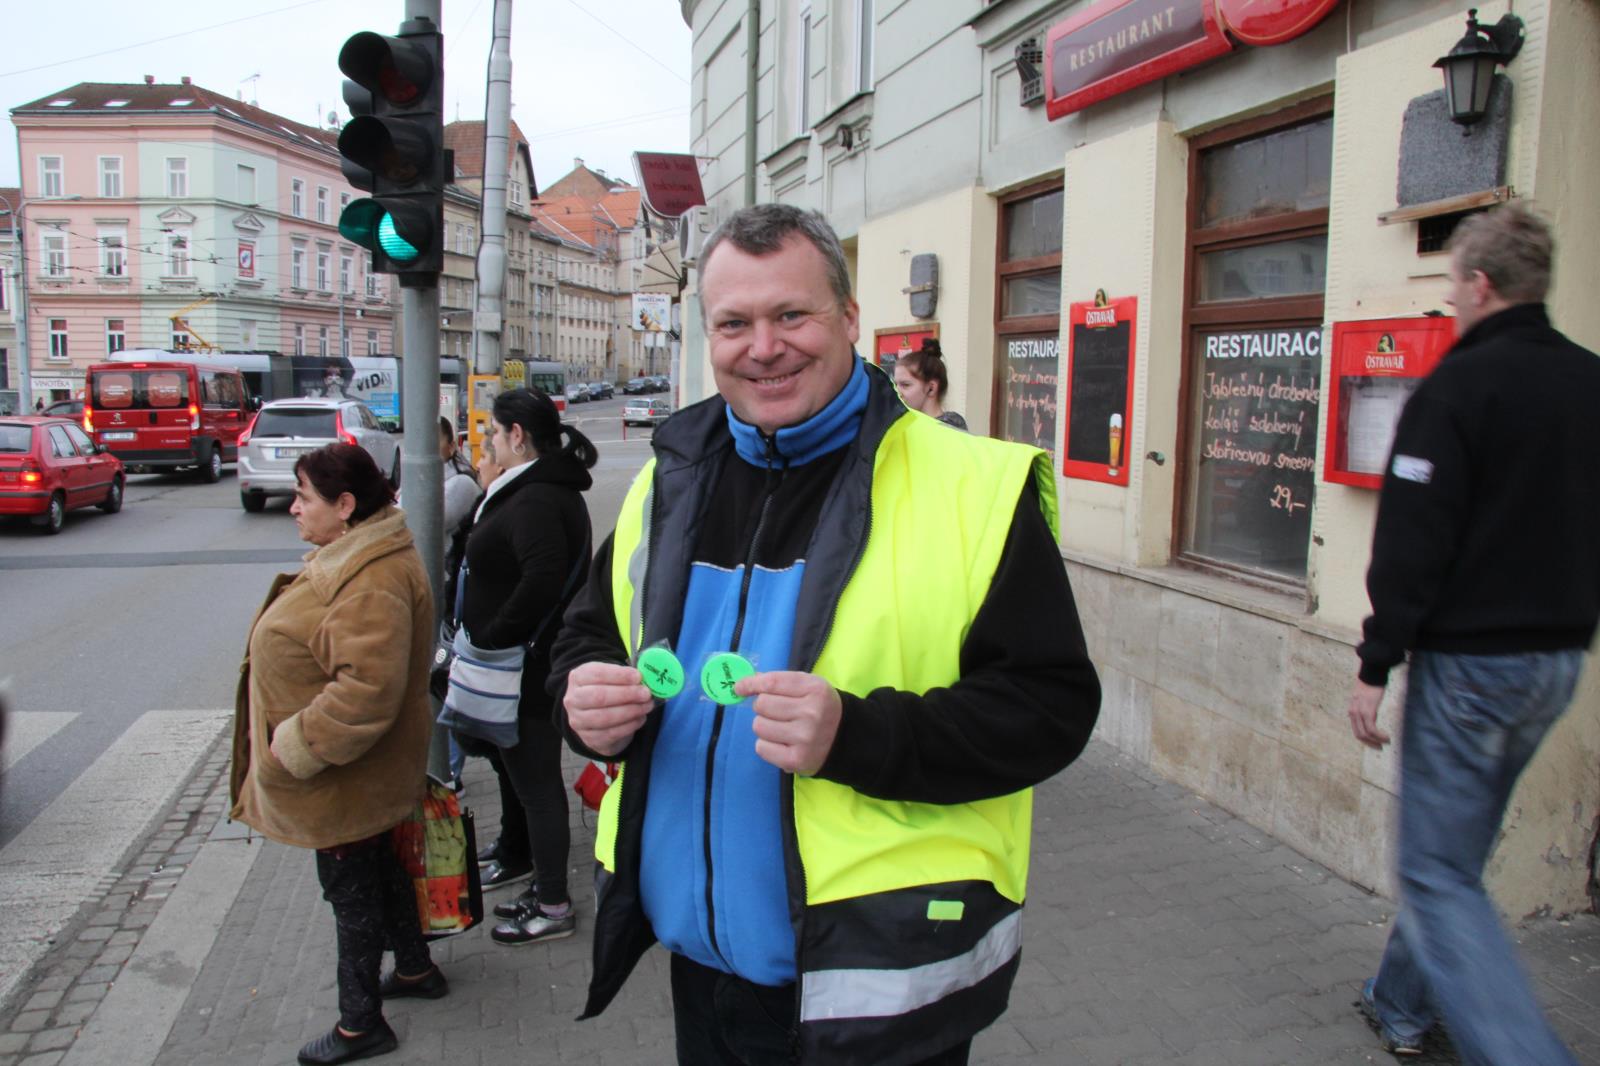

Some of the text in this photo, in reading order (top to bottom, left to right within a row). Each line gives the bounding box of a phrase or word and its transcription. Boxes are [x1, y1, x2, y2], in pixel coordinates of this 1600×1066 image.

[1069, 6, 1175, 72] RESTAURANT
[1086, 307, 1117, 326] OSTRAVAR
[1365, 354, 1405, 370] OSTRAVAR
[1249, 411, 1304, 451] zdobený
